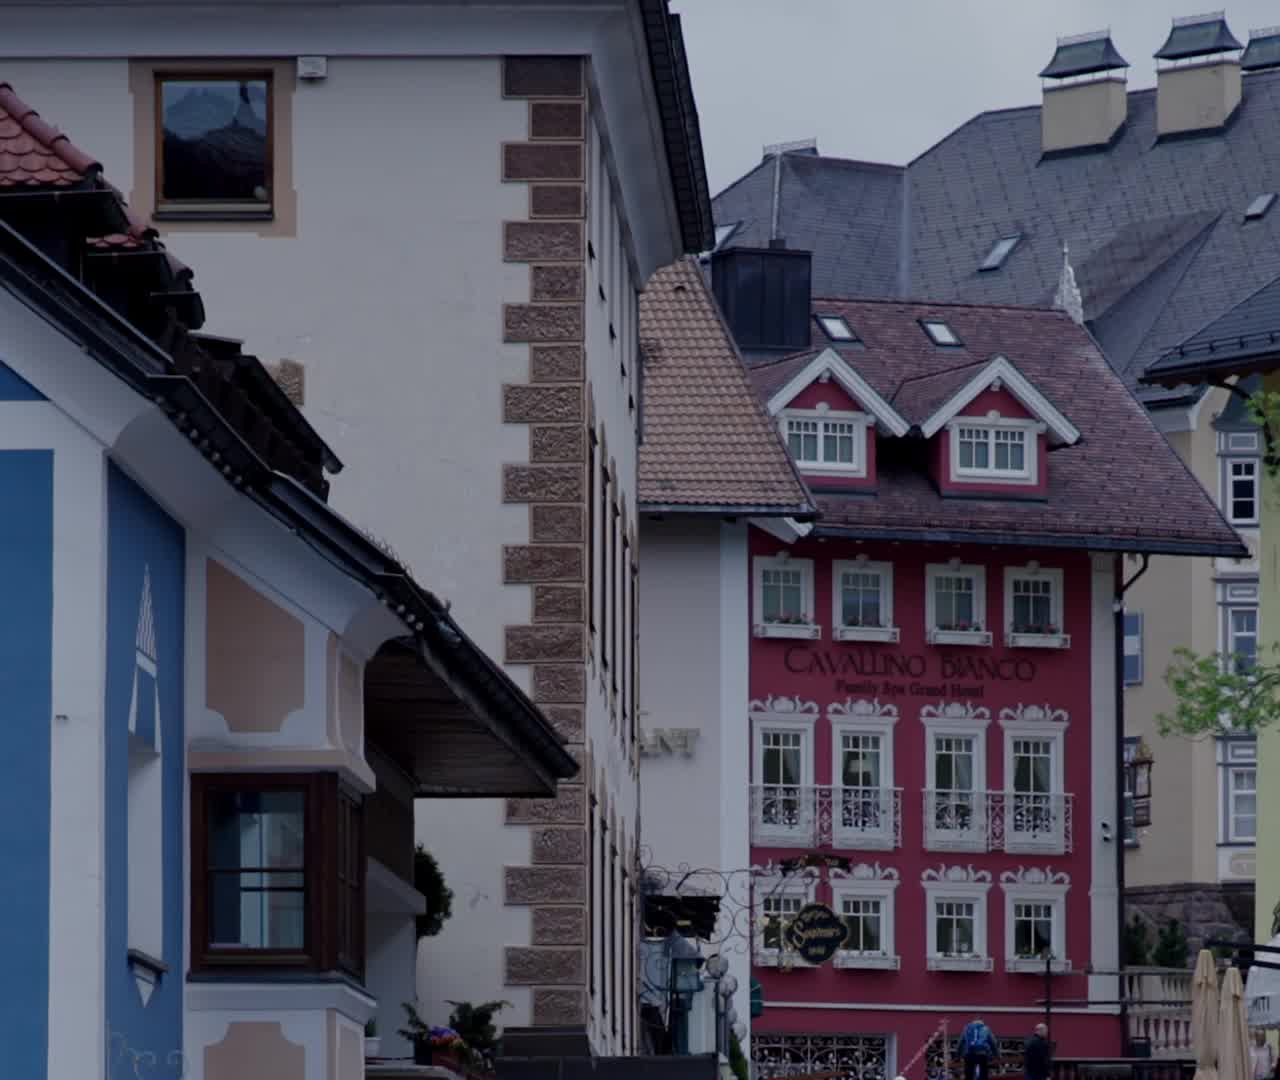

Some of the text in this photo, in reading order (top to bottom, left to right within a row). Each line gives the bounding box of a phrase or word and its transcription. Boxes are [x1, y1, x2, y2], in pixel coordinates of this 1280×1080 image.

[784, 645, 1036, 681] CAVALLINO BIANCO
[910, 684, 948, 697] Grand
